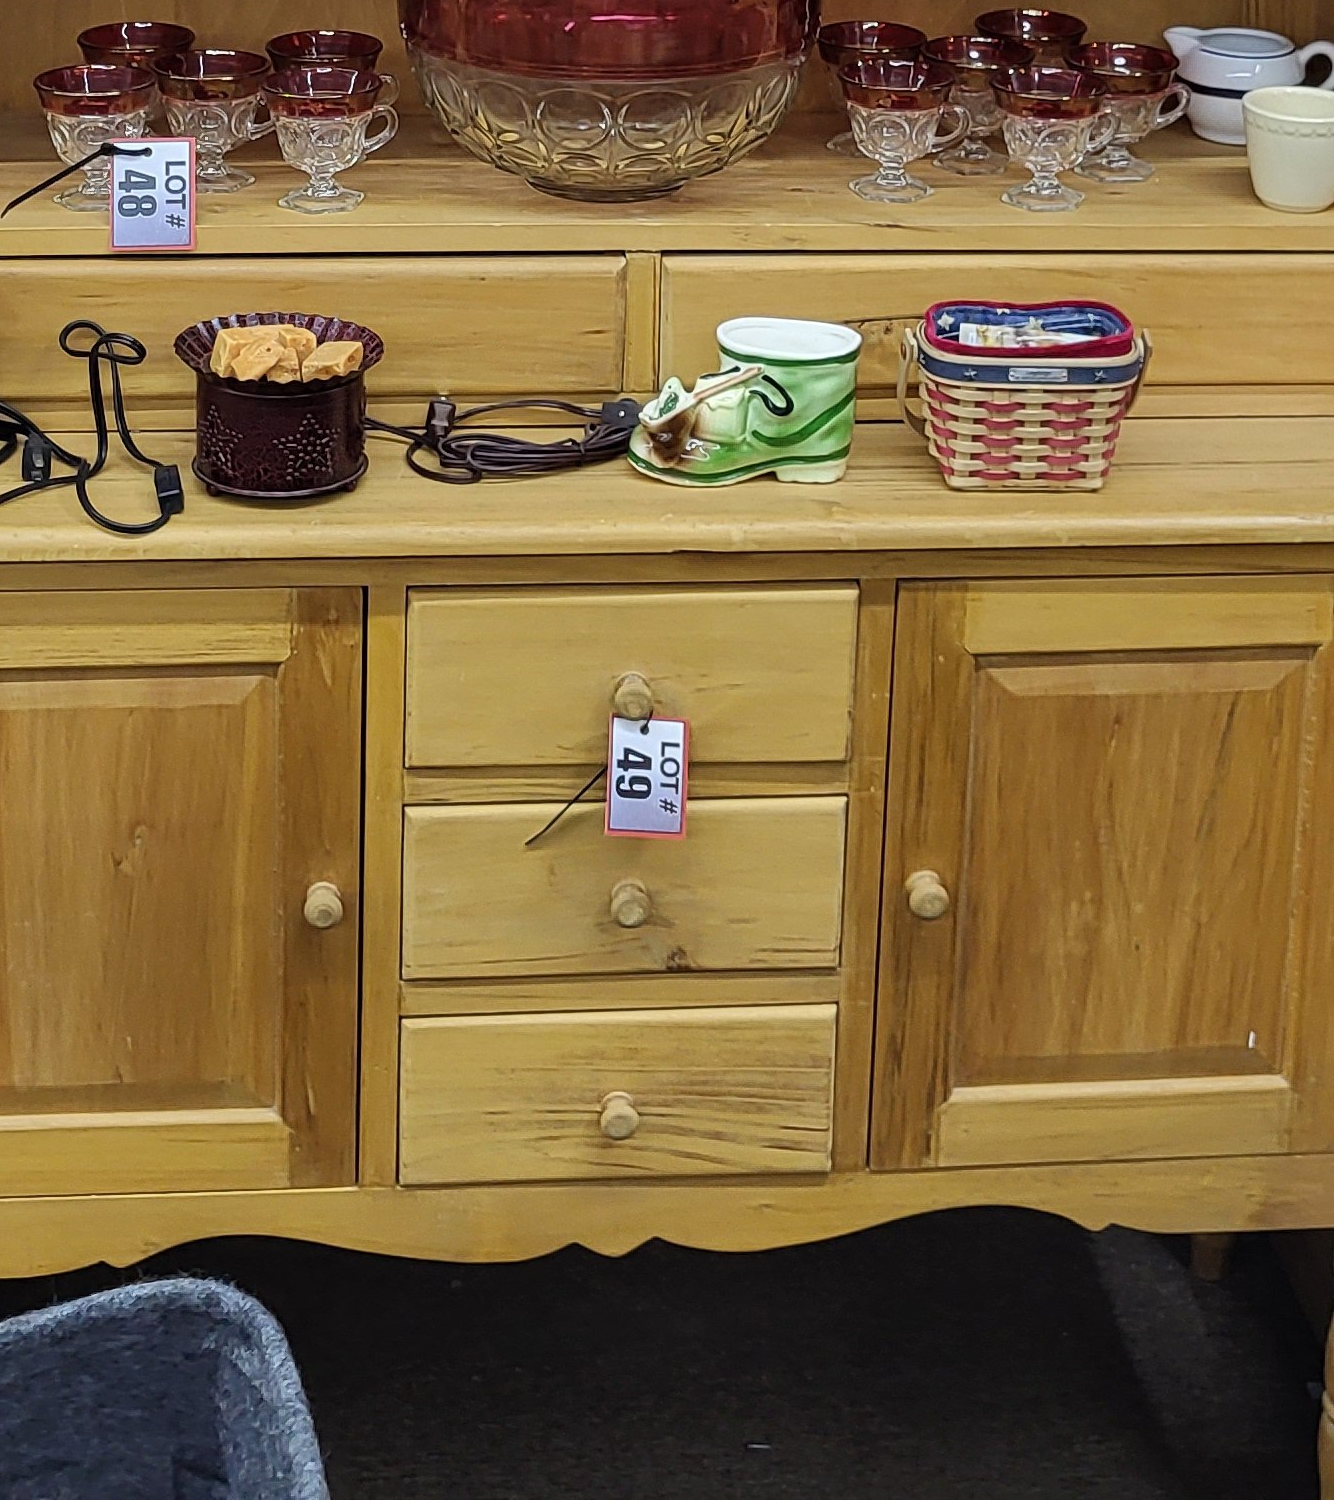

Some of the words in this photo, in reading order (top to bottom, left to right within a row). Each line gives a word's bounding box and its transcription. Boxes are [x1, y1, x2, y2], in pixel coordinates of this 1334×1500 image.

[117, 169, 157, 217] 48
[165, 161, 187, 210] LOT
[165, 213, 186, 229] #
[615, 747, 653, 800] 49
[660, 741, 681, 795] LOT
[659, 797, 678, 815] #
